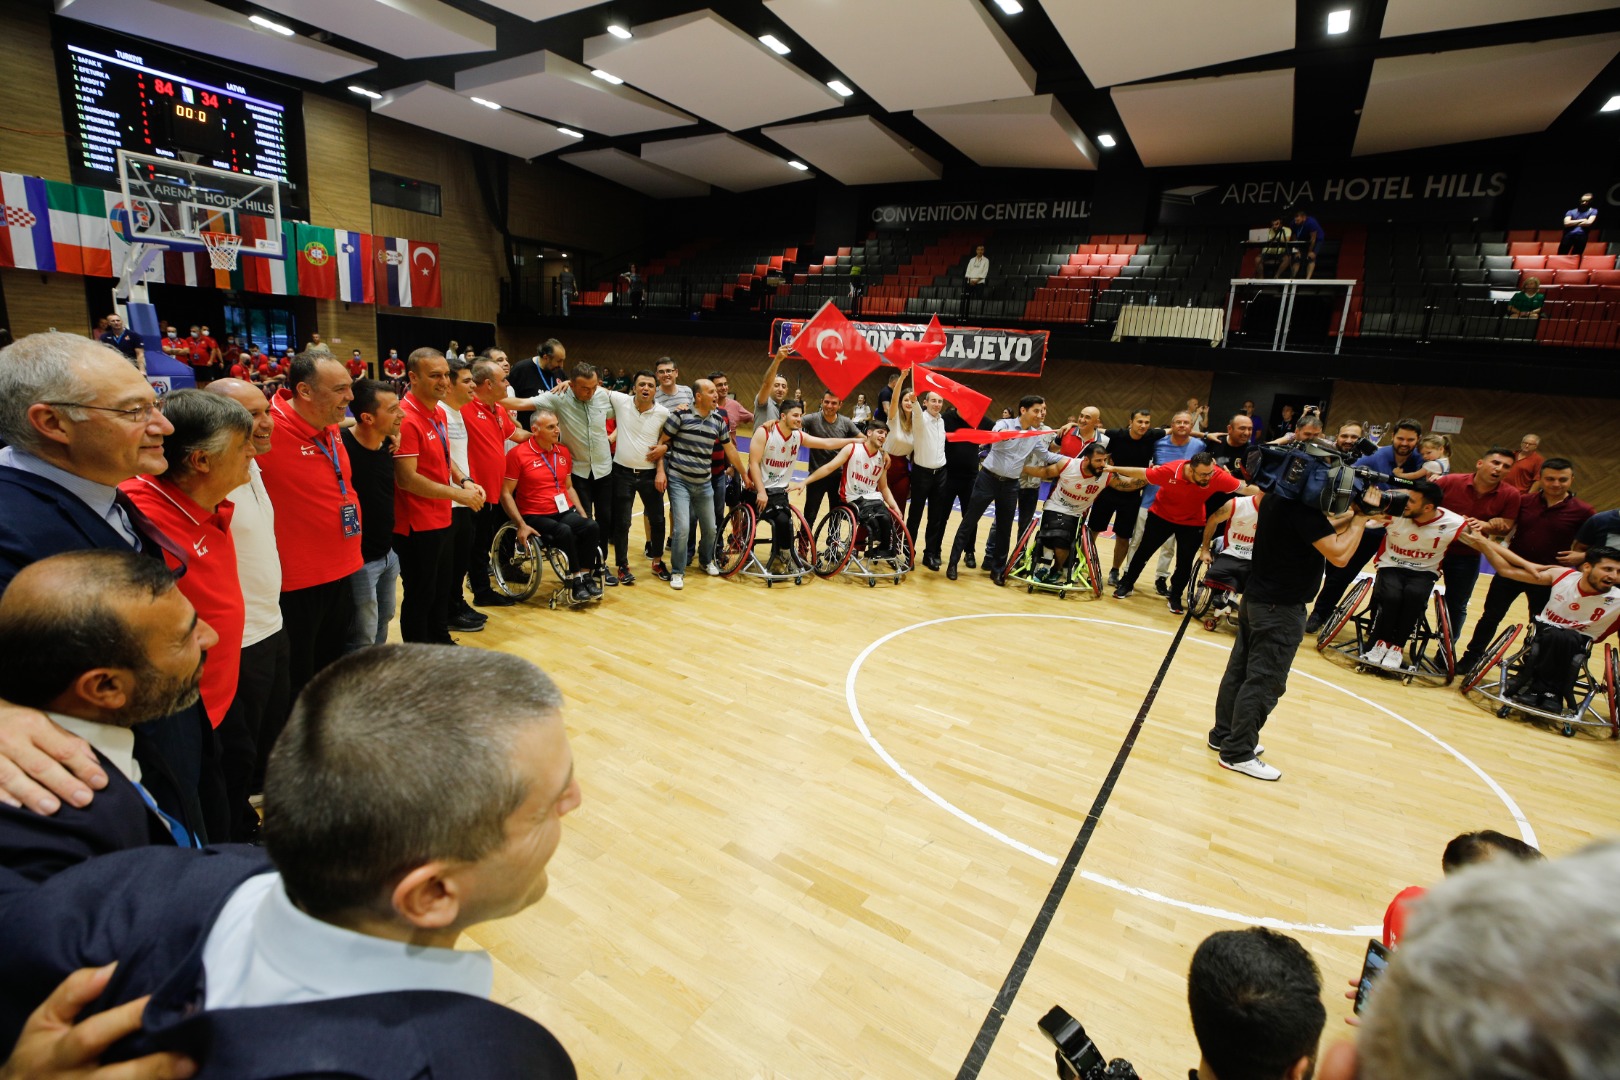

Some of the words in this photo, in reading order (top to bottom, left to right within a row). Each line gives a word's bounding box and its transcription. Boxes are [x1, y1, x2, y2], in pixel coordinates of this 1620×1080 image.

[154, 78, 174, 97] 84
[200, 91, 219, 108] 34
[154, 184, 193, 200] ARENA
[205, 192, 243, 209] HOTEL
[246, 200, 275, 214] HILLS
[1220, 180, 1315, 205] ARENA
[1323, 176, 1414, 201] HOTEL
[1423, 172, 1508, 199] HILLS
[871, 204, 978, 222] CONVENTION
[982, 201, 1048, 221] CENTER
[1052, 200, 1092, 219] HILL
[872, 465, 882, 476] 17
[1432, 537, 1440, 548] 1
[1590, 608, 1606, 622] 8
